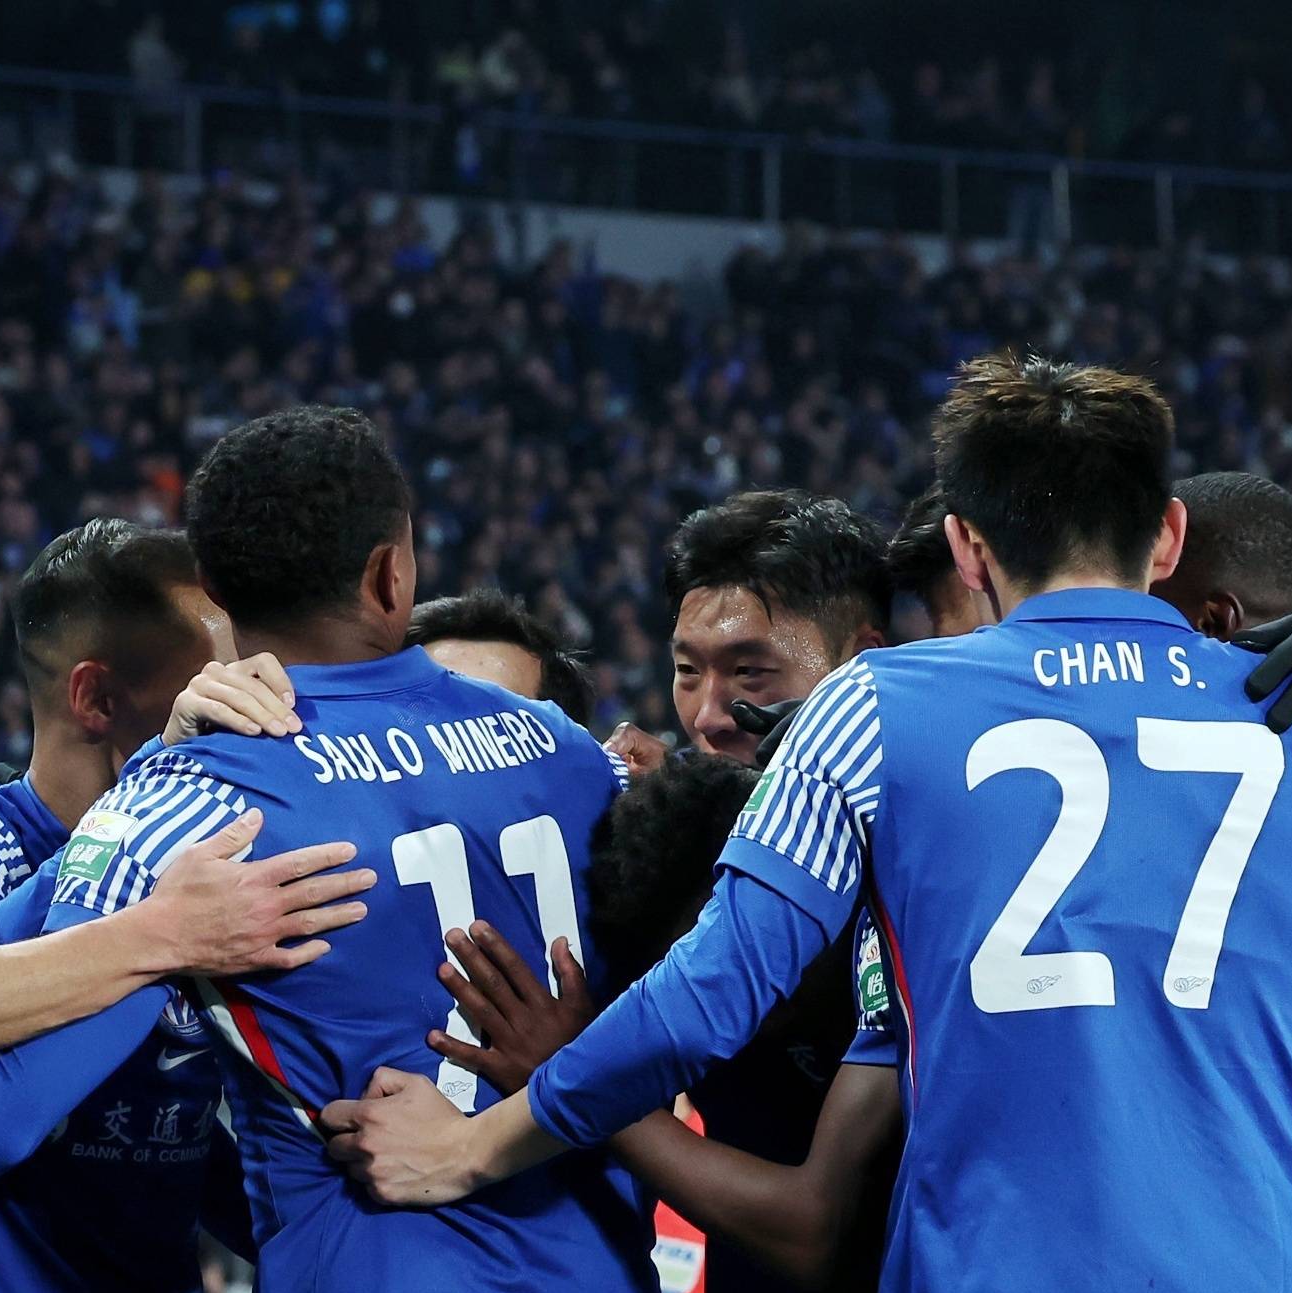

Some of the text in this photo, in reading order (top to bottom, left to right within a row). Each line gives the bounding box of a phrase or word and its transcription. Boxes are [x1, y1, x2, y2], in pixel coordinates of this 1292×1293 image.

[1033, 641, 1207, 690] CHAN S.
[293, 709, 556, 783] SAULO MINEIRO
[966, 716, 1285, 1014] 27
[391, 814, 586, 1113] 11
[867, 971, 886, 997] 怡
[70, 1142, 124, 1161] BANK
[132, 1148, 151, 1162] OF
